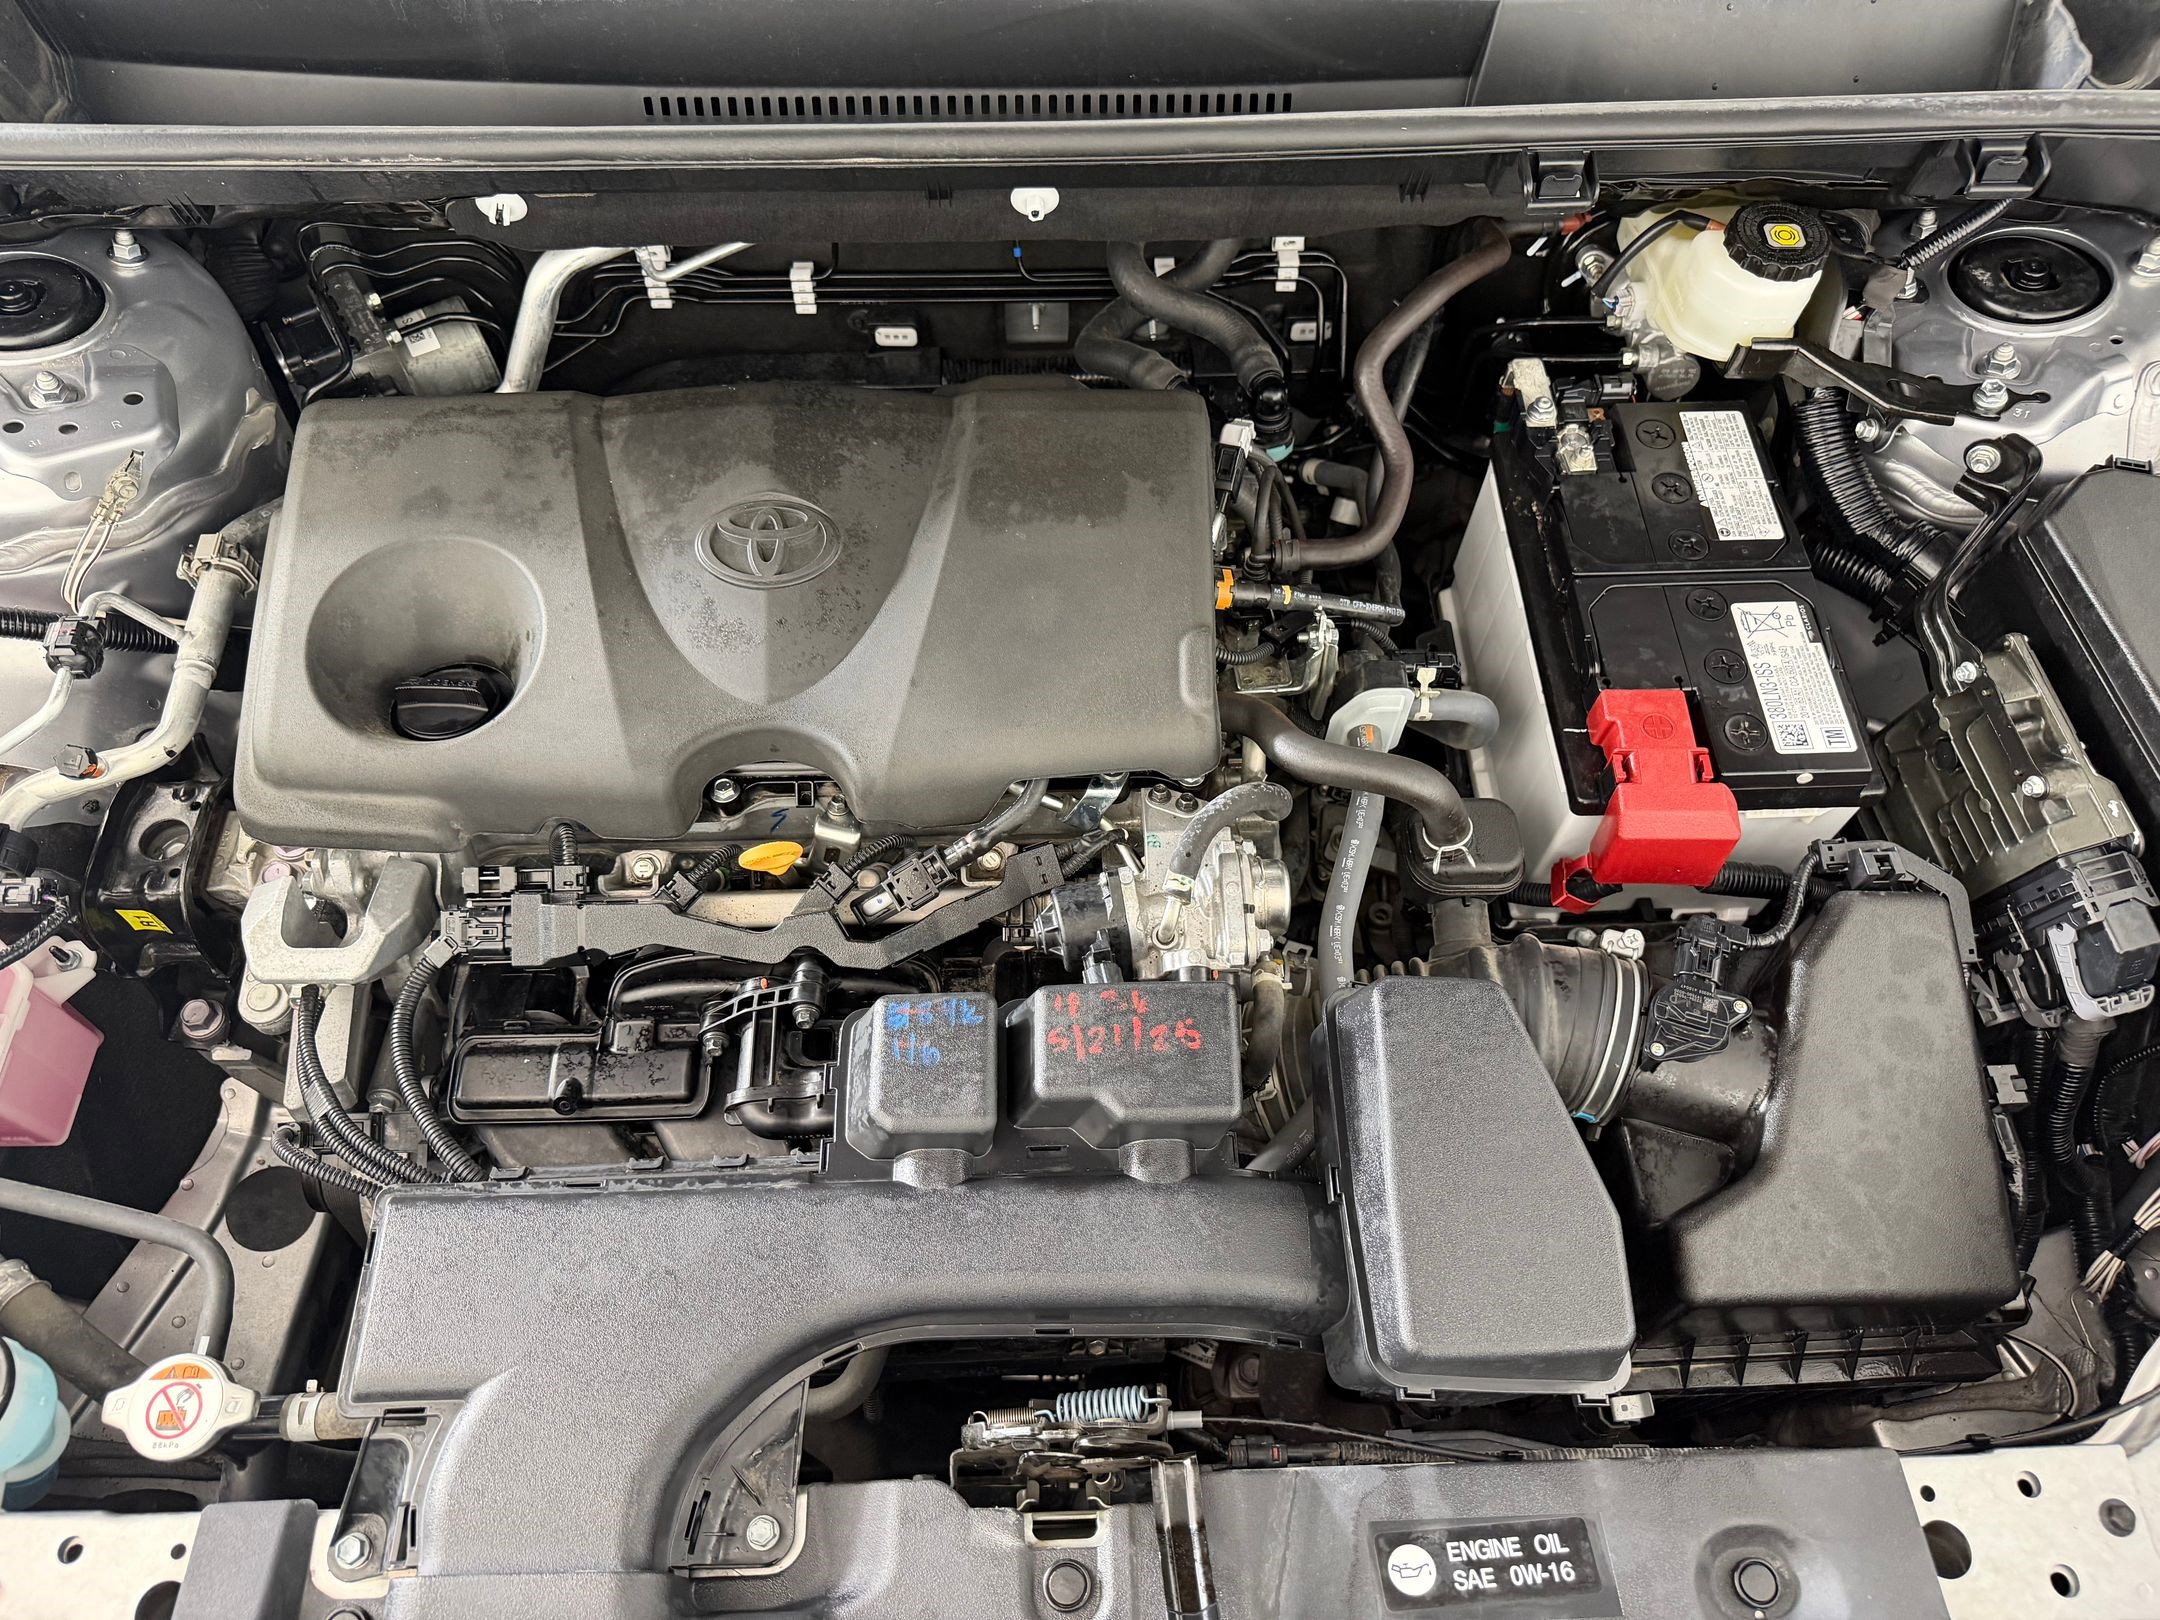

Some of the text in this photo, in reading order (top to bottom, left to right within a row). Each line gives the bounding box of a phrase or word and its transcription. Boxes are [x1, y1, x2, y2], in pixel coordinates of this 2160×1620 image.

[1785, 613, 1797, 628] Pb
[1824, 729, 1848, 746] TM
[1446, 1532, 1570, 1562] ENGINE OIL
[1452, 1560, 1576, 1591] SAE 0W-16
